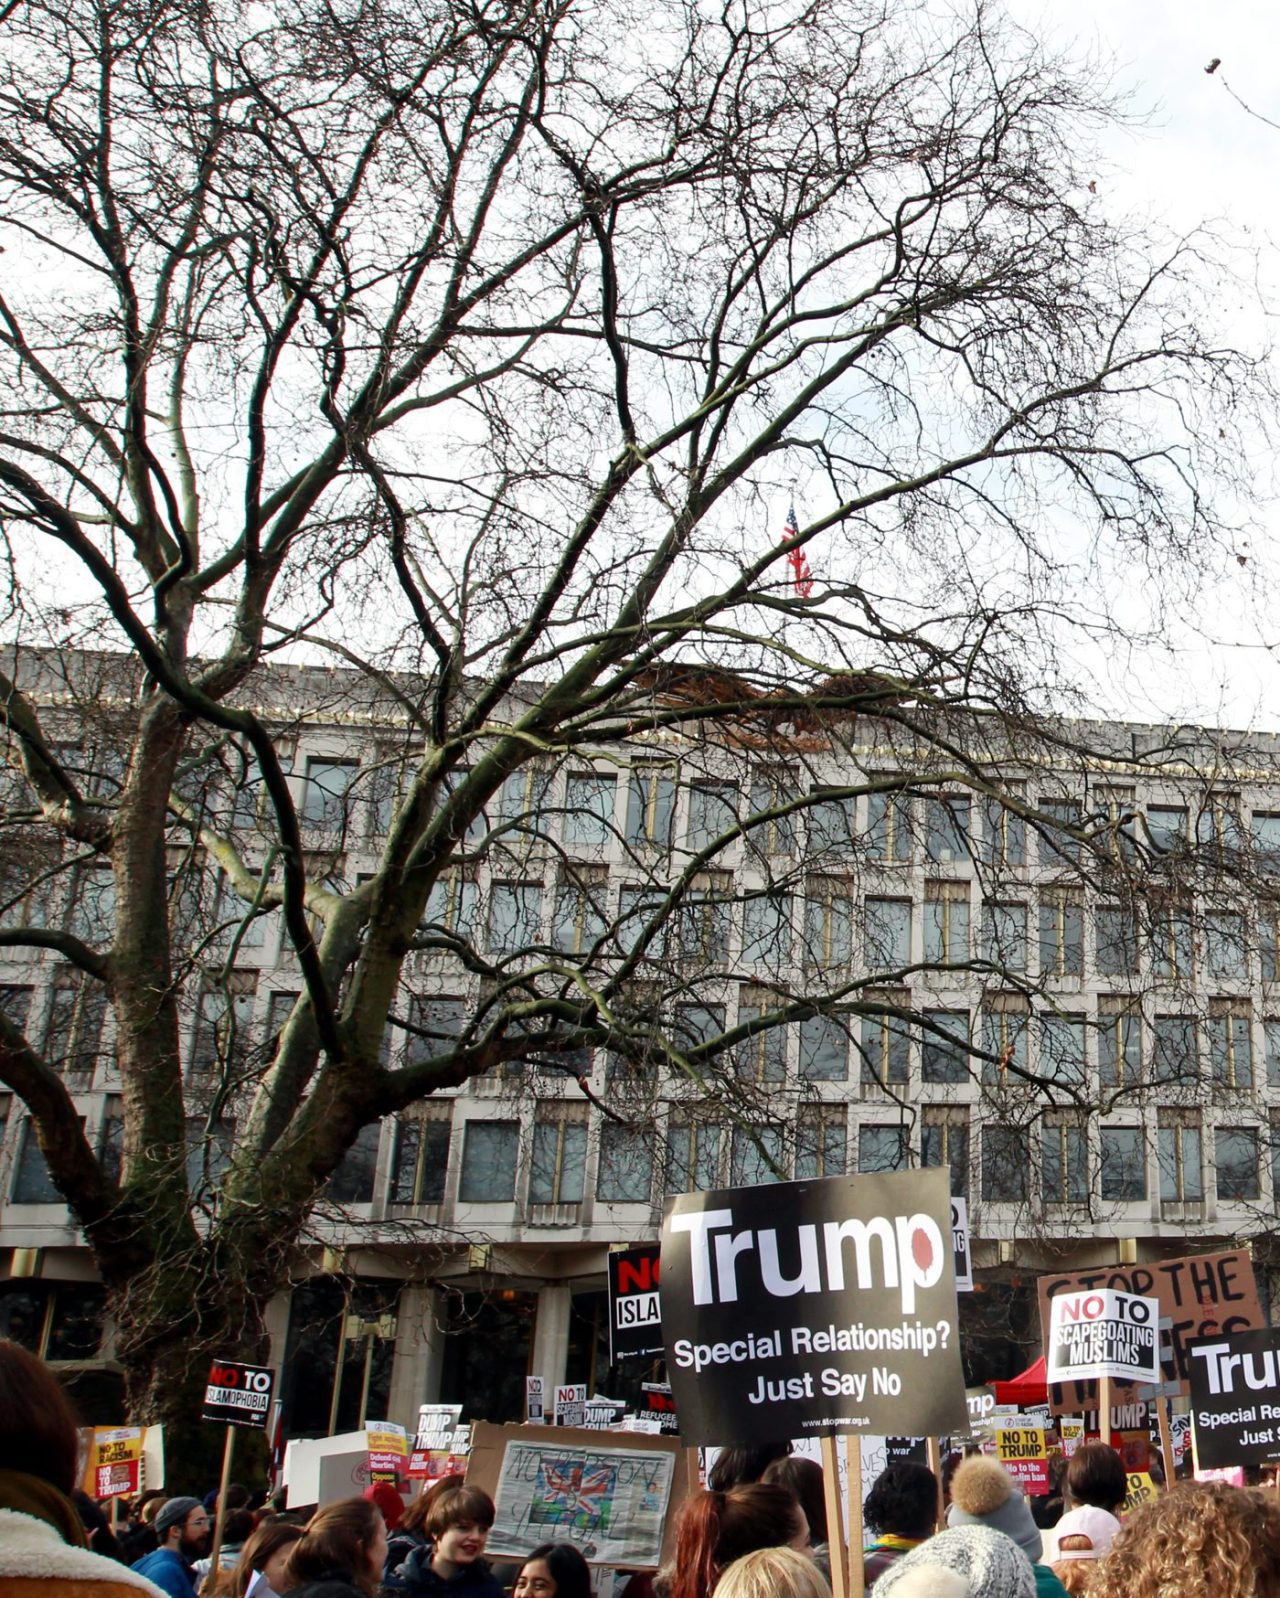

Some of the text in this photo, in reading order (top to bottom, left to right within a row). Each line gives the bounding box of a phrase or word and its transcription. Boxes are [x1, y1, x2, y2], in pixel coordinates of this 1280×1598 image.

[670, 1208, 944, 1314] Trump
[1160, 1256, 1244, 1307] THE
[1060, 1296, 1149, 1324] NO TO
[1056, 1320, 1154, 1349] SCAPEGOATING
[674, 1320, 950, 1373] Special Relationship?
[1069, 1342, 1140, 1366] MUSLIMS
[208, 1365, 270, 1392] NO TO
[749, 1367, 901, 1404] Just Say No
[559, 1388, 585, 1401] NO TO
[419, 1414, 451, 1431] DUMP
[585, 1408, 616, 1423] DUMP
[1199, 1406, 1256, 1429] Special
[416, 1431, 452, 1449] TRUMP
[1002, 1431, 1038, 1443] NO TO
[1240, 1430, 1274, 1446] Just
[114, 1442, 125, 1450] TO
[893, 1447, 911, 1456] war
[1000, 1444, 1042, 1458] TRUMP
[99, 1466, 111, 1477] NO
[507, 1448, 542, 1482] NO
[1019, 1463, 1027, 1471] to
[1028, 1462, 1040, 1471] the
[99, 1477, 110, 1486] TO
[1032, 1472, 1045, 1481] ban
[99, 1482, 131, 1496] TRUMP
